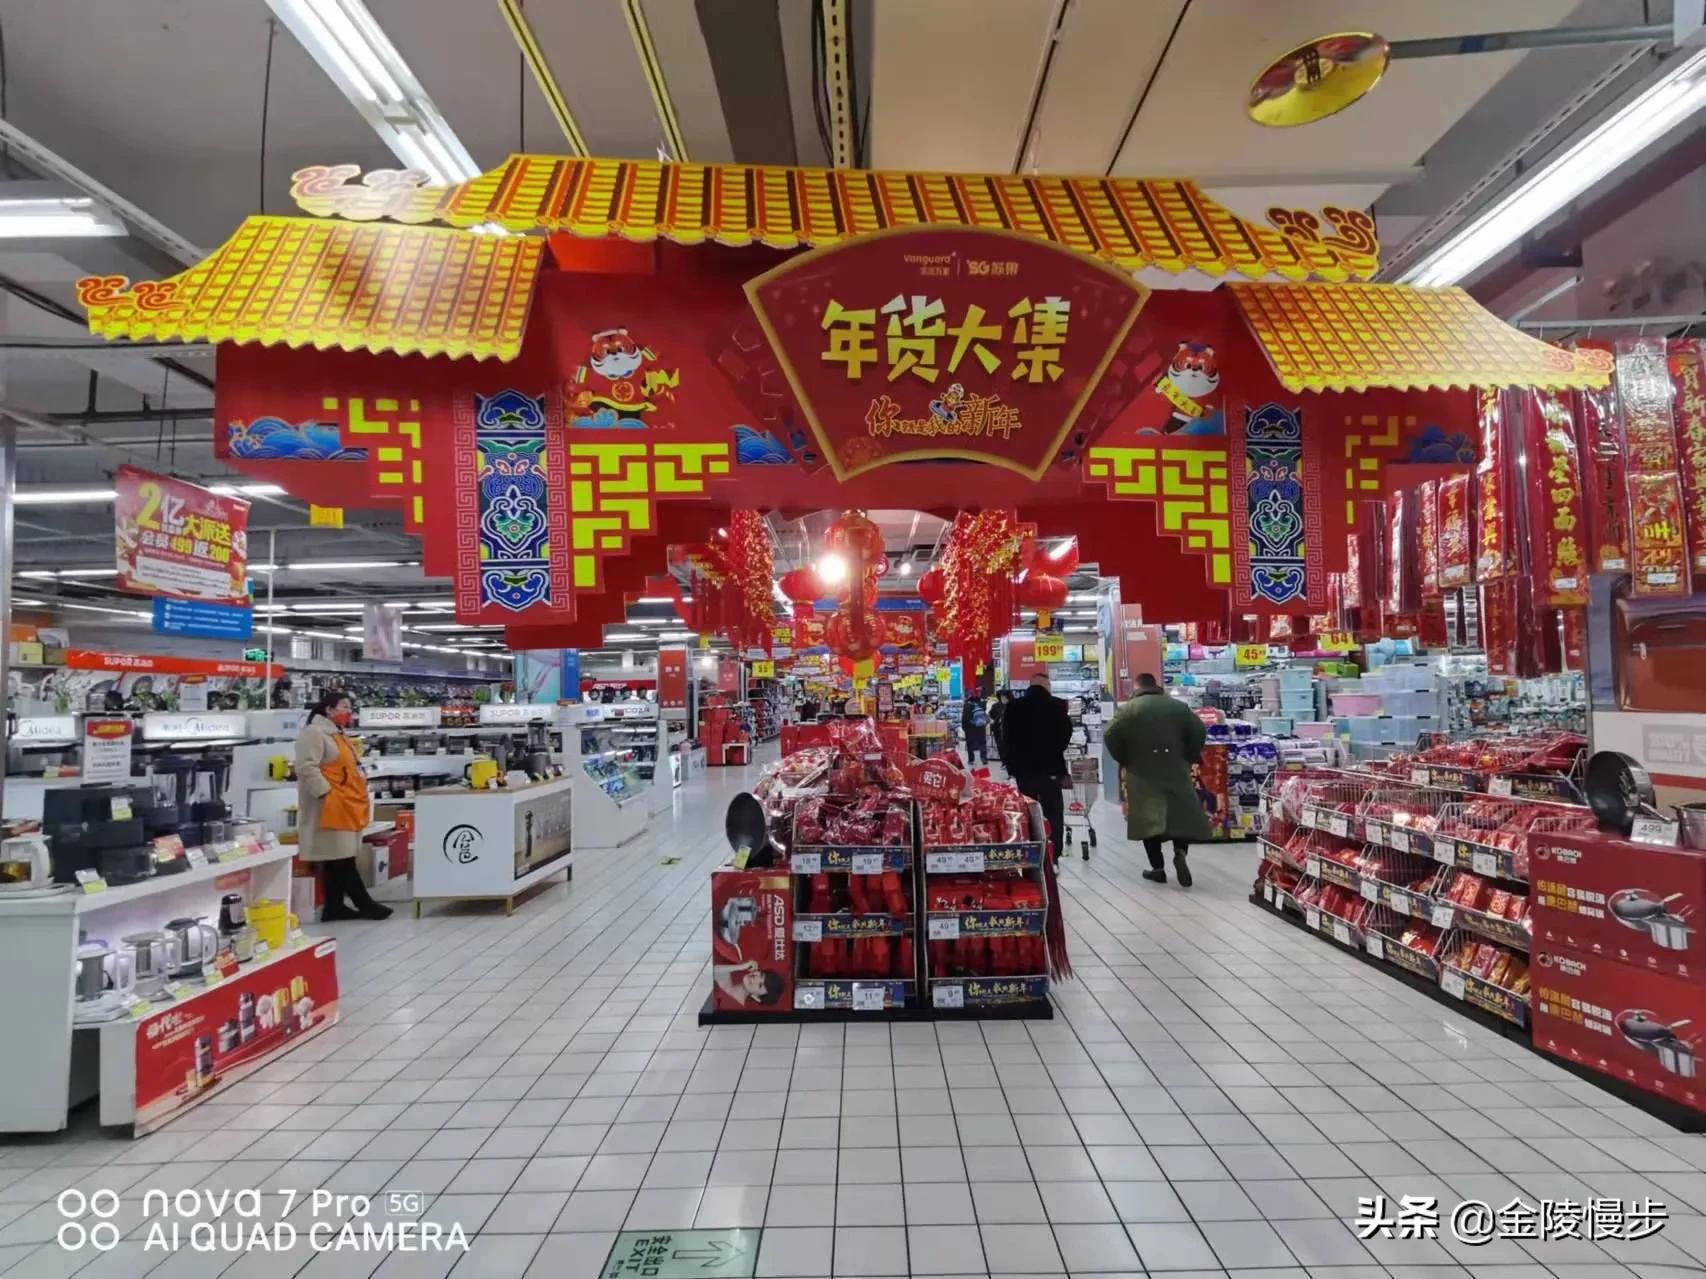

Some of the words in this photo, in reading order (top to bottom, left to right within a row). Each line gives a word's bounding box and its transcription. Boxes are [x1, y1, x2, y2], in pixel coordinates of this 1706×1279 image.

[903, 254, 951, 265] Vanguard
[821, 294, 1071, 383] 年货大集
[1036, 645, 1056, 657] 199
[1243, 649, 1259, 661] 45
[103, 656, 132, 666] SUPOR
[370, 712, 400, 720] SUPOR
[1640, 824, 1662, 834] 499
[1551, 846, 1582, 859] KOBACH
[773, 894, 785, 924] ASD
[1553, 955, 1587, 972] KOBACH
[626, 1238, 650, 1273] EXIT
[640, 1235, 672, 1277] 安全出口
